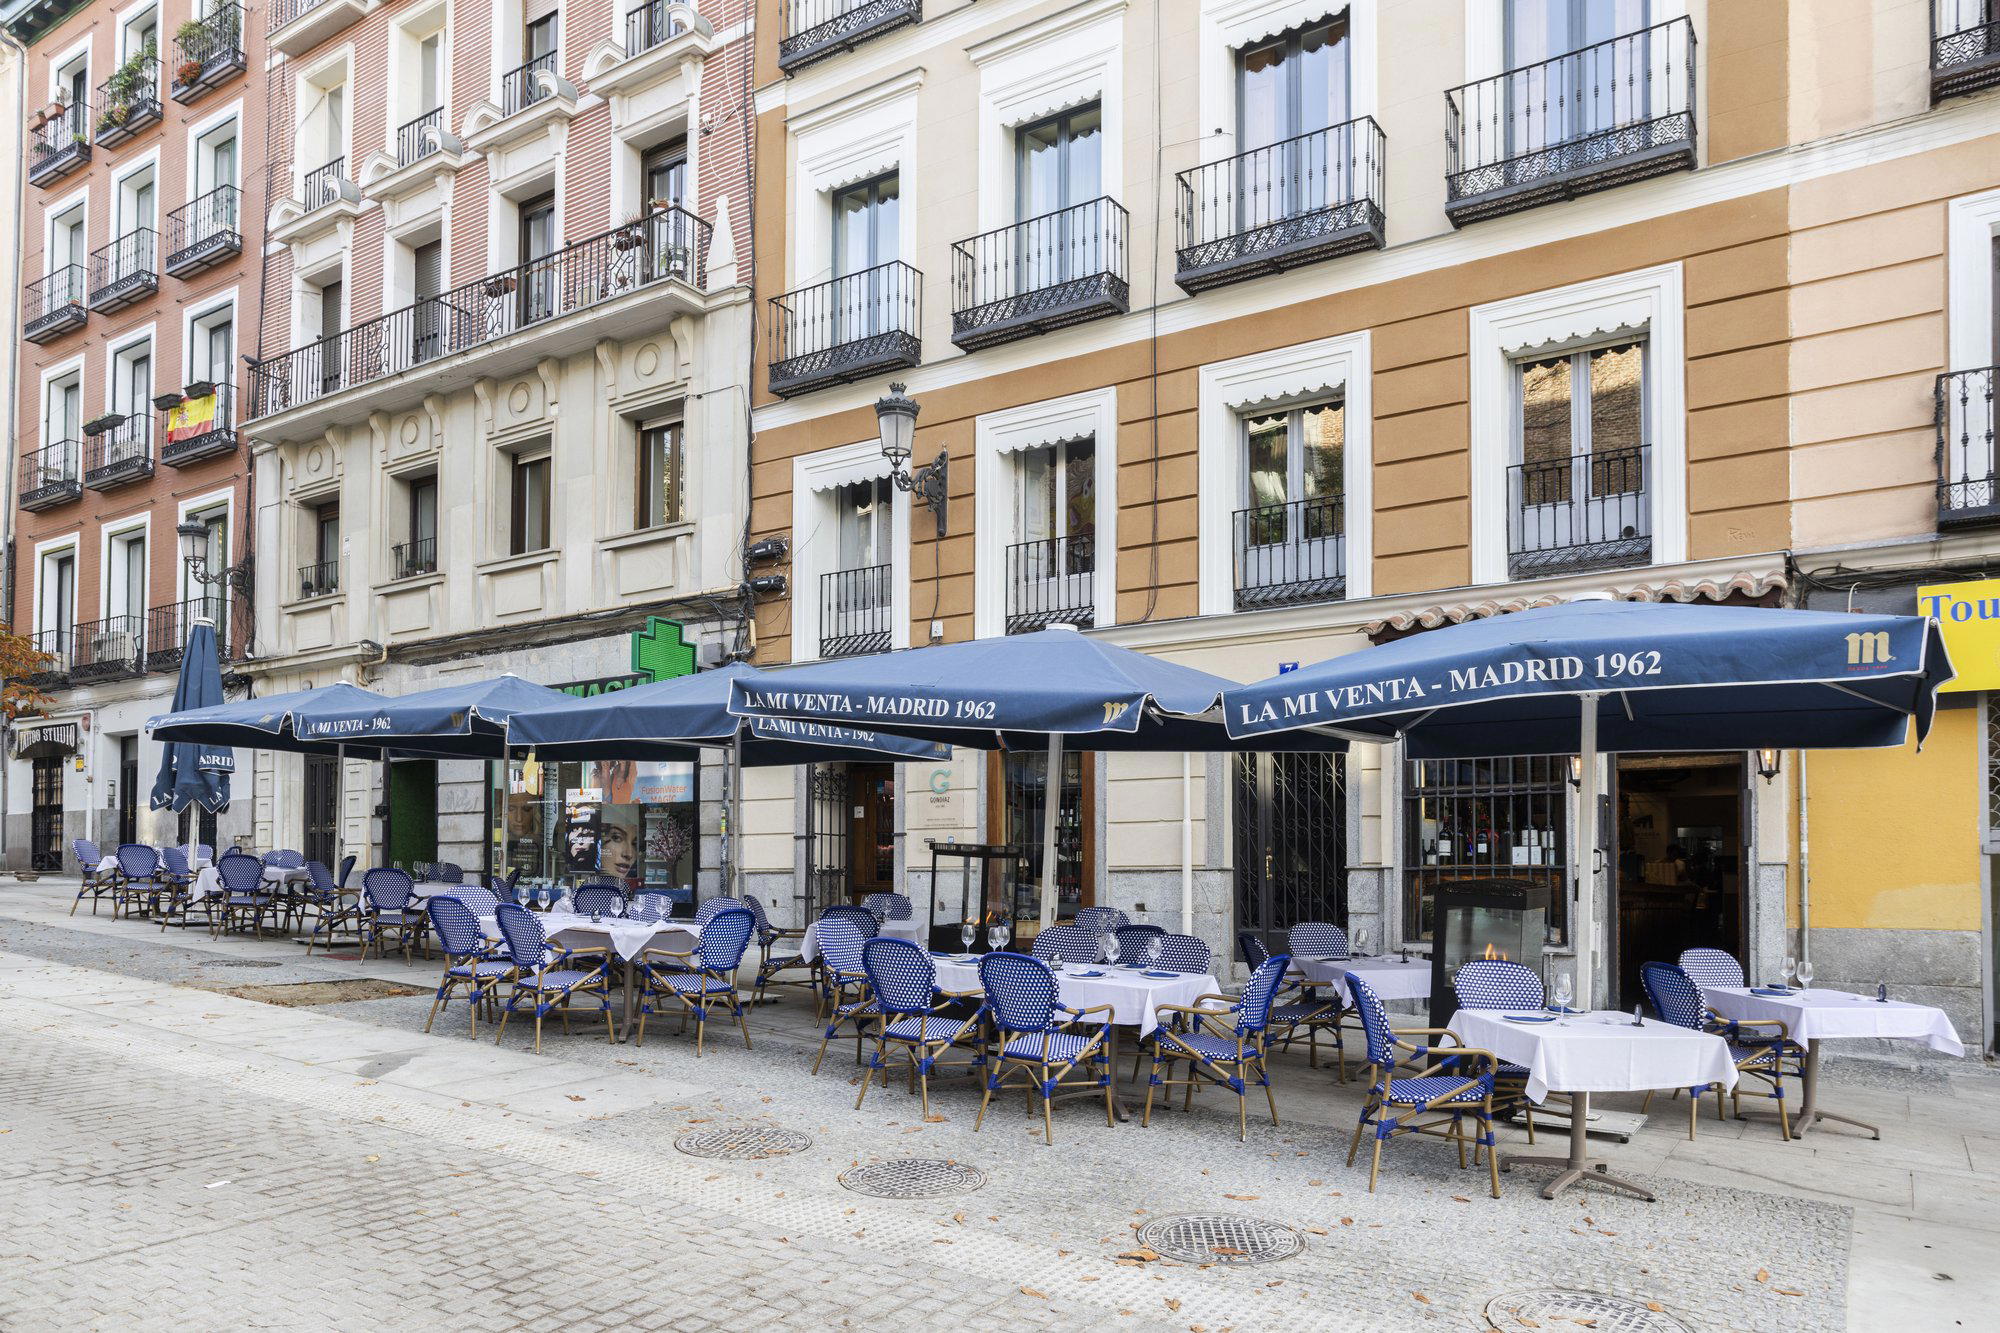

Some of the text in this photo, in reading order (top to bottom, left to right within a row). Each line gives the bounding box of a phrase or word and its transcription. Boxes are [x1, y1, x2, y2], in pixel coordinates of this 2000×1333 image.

[1240, 701, 1278, 725] LA
[1282, 692, 1319, 718] MI
[1325, 676, 1426, 709] VENTA
[1448, 656, 1584, 693] MADRID
[1594, 650, 1663, 678] 1962
[745, 692, 766, 708] LA
[766, 692, 789, 710] MI
[793, 694, 853, 713] VENTA
[867, 696, 949, 717] MADRID
[955, 700, 996, 720] 1962
[42, 724, 75, 748] STUDIO
[317, 721, 332, 734] MI
[333, 719, 363, 733] VENTA
[372, 717, 391, 730] 1962
[758, 717, 780, 732] LA
[780, 719, 797, 735] MI
[799, 722, 843, 739] VENTA
[852, 729, 875, 742] 1962
[199, 755, 235, 767] ADRID
[152, 792, 172, 806] LA
